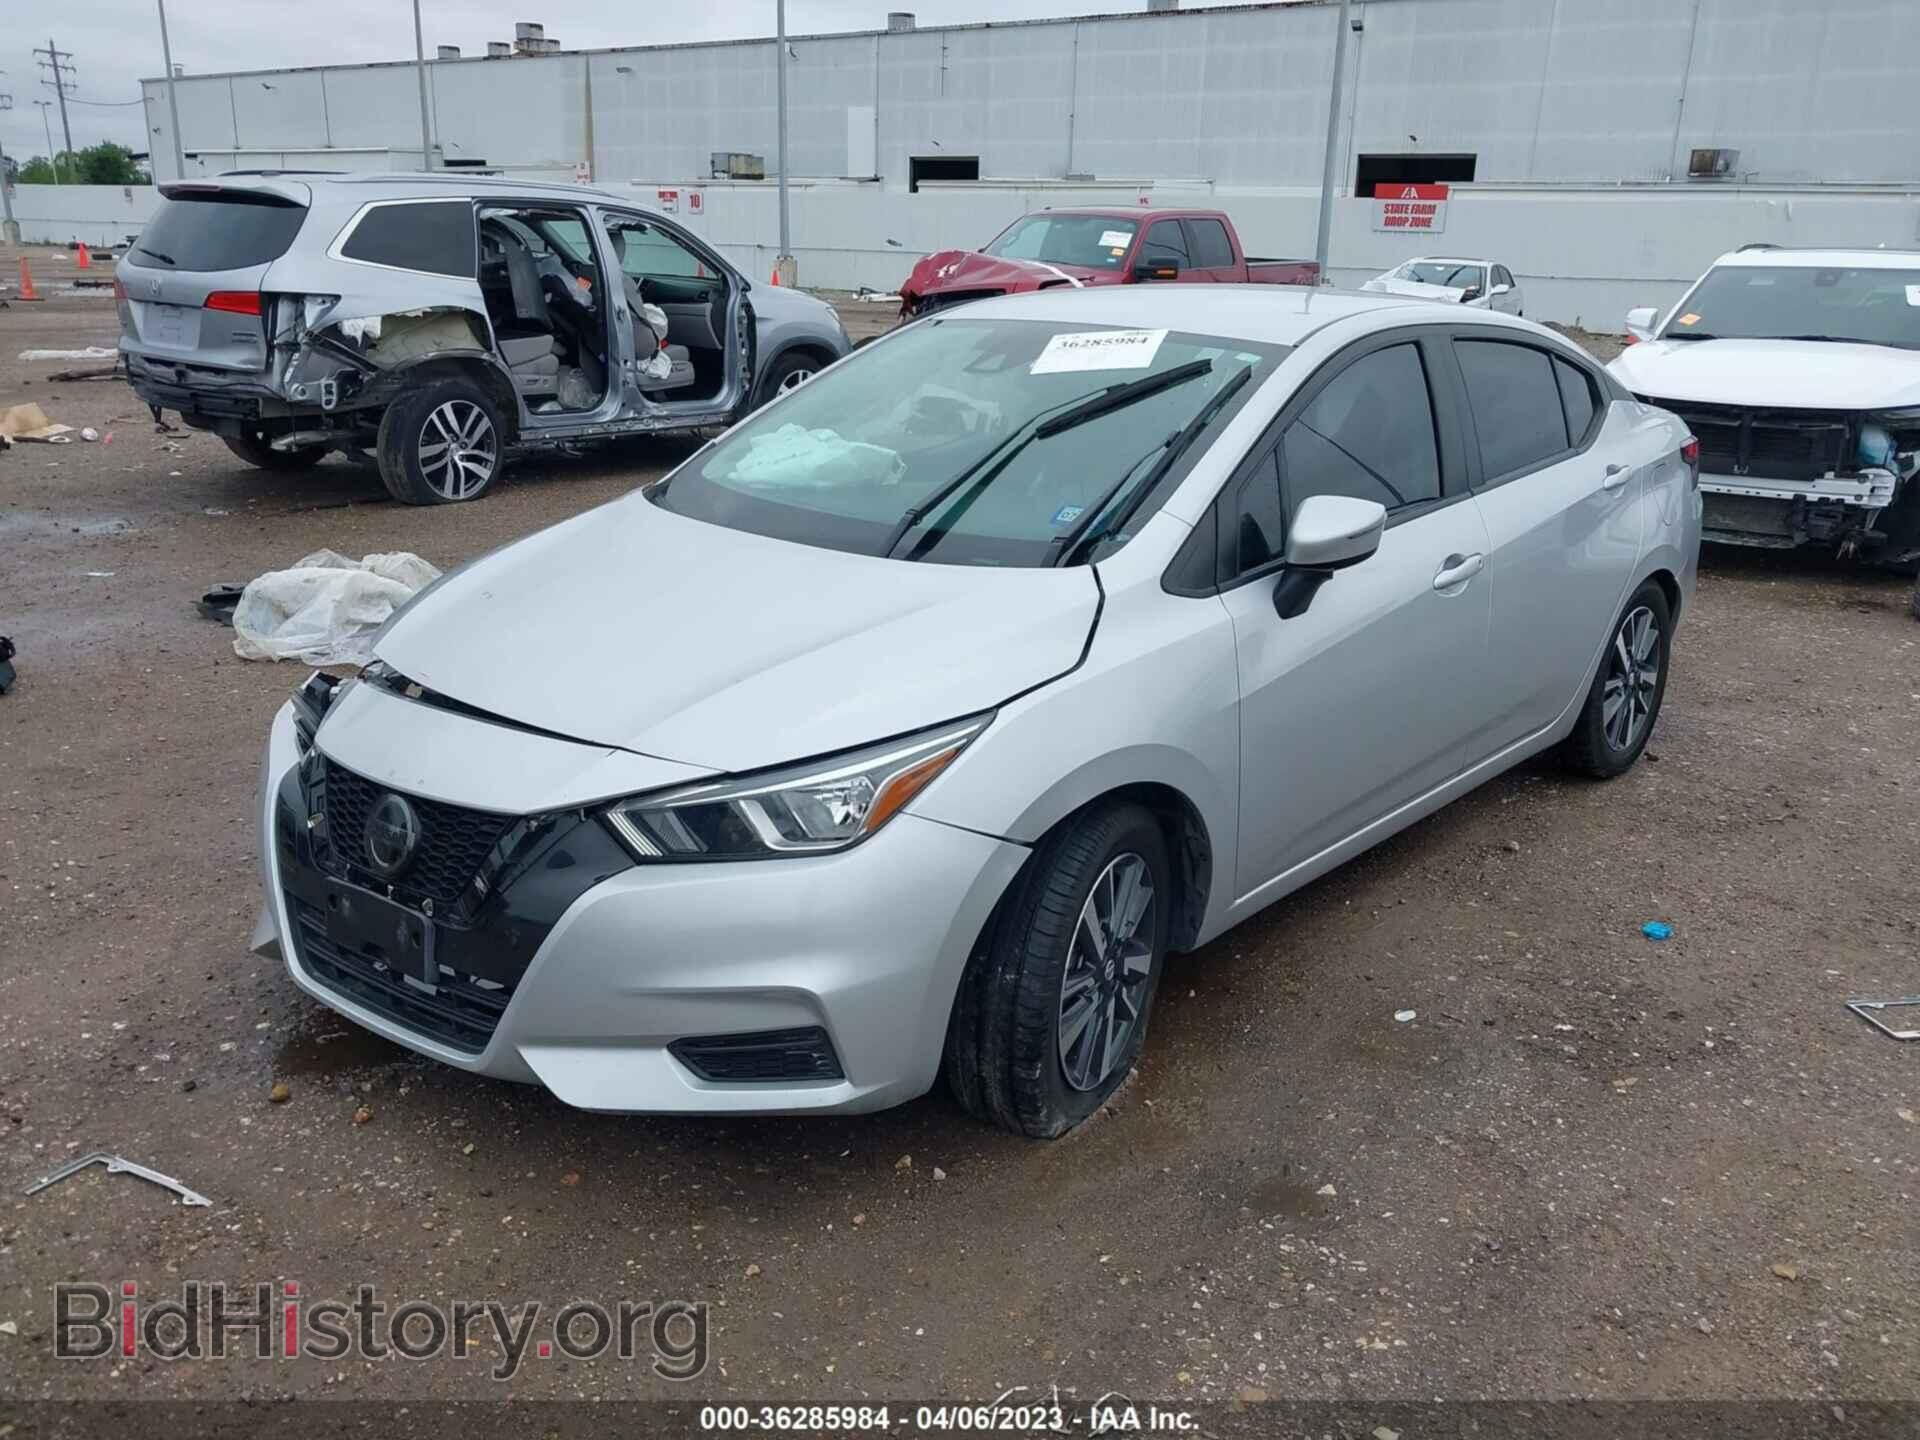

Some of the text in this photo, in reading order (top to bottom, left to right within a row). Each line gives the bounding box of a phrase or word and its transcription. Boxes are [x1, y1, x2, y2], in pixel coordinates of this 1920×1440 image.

[690, 194, 700, 208] 10
[1384, 203, 1437, 214] STATE FARM
[1384, 216, 1432, 227] DROP ZONE
